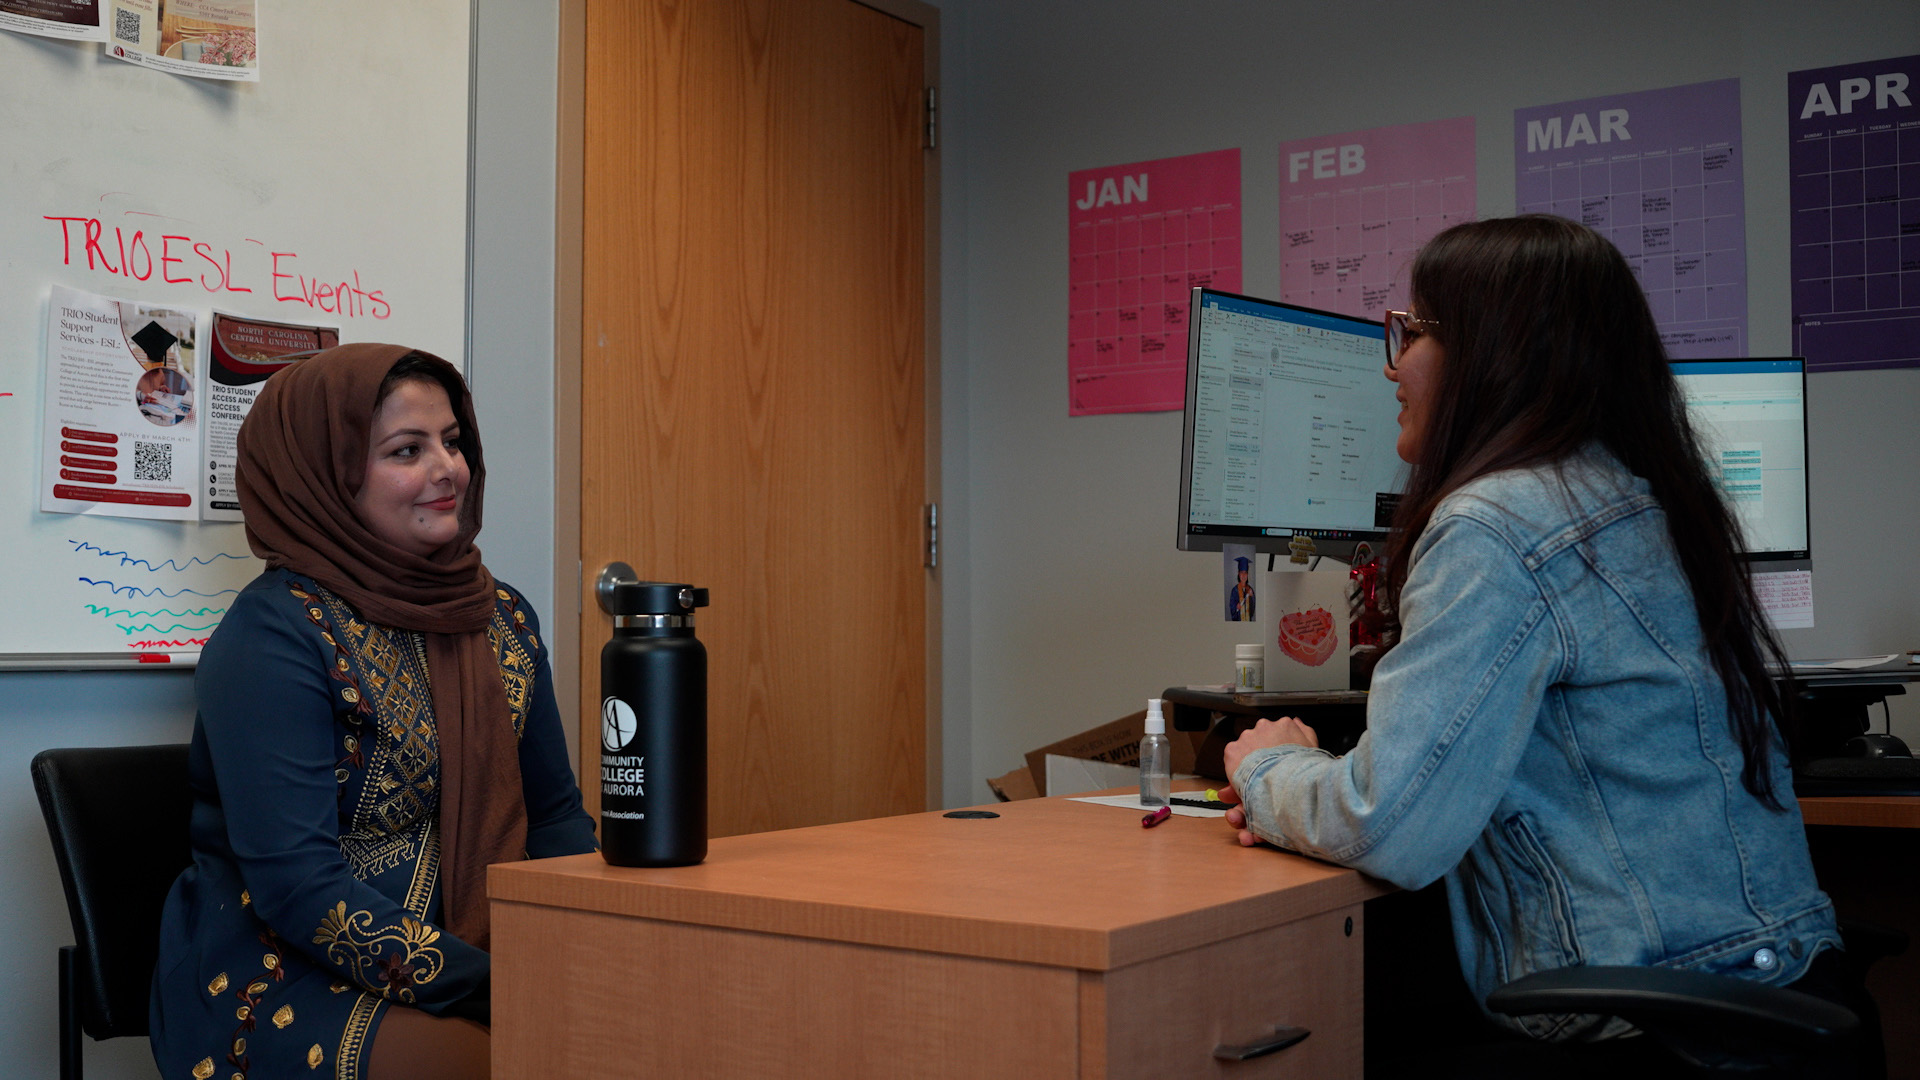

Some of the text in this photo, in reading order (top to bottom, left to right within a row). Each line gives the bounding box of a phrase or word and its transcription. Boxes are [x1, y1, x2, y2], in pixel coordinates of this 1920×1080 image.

[1800, 72, 1912, 119] APR
[1527, 108, 1632, 153] MAR
[1290, 144, 1366, 183] FEB
[1076, 173, 1148, 210] JAN
[43, 216, 392, 320] TRIO ESL Events
[61, 307, 119, 325] TRIO Student
[60, 319, 93, 333] Support
[238, 326, 308, 340] NORTH CAROLINA
[60, 331, 95, 345] Services
[100, 338, 121, 349] ESL:
[230, 334, 317, 349] CENTRAL UNIVERSITY
[212, 394, 236, 403] ACCESS
[227, 387, 256, 396] STUDENT
[212, 403, 240, 412] SUCCESS
[212, 412, 244, 420] CONFEREN
[1109, 740, 1140, 760] WITH
[602, 755, 644, 766] OMMUNITY
[604, 784, 644, 796] AURORA
[610, 810, 644, 820] Association
